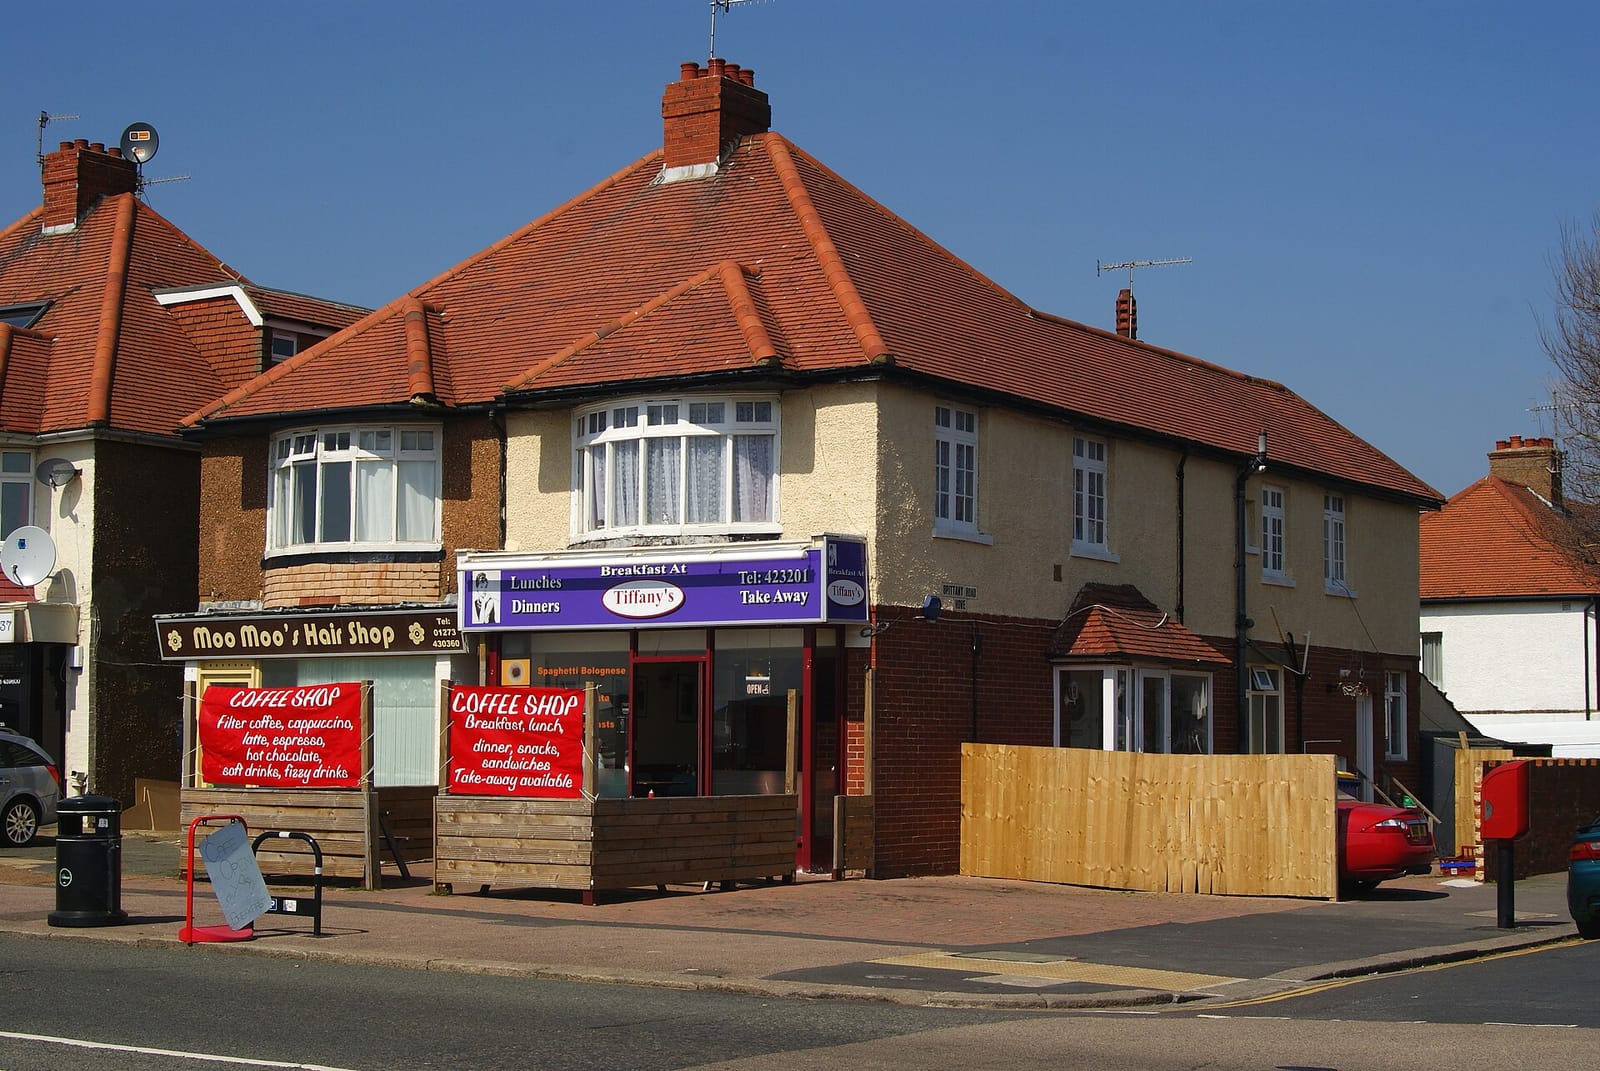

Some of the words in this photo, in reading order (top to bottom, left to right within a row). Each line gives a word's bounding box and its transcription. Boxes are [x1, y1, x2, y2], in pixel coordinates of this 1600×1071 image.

[600, 564, 667, 577] Breakfast
[669, 563, 688, 575] At
[738, 570, 762, 585] Tel:
[764, 568, 809, 584] 423201
[828, 567, 856, 576] Breakfast
[510, 575, 562, 590] Lunches
[613, 588, 675, 607] Tiffany's
[740, 589, 771, 604] Take
[773, 588, 809, 606] Away
[832, 585, 861, 600] Tiffany's
[511, 599, 561, 614] Dinners
[436, 617, 450, 625] Tel:
[193, 626, 236, 649] Moo
[240, 623, 299, 647] Moo's
[303, 622, 342, 646] Hair
[348, 621, 395, 649] Shop
[433, 629, 456, 637] 01273
[537, 667, 578, 676] Spaghetti
[581, 666, 626, 677] Bolognese
[229, 690, 294, 708] COFFEE
[290, 687, 341, 707] SHOP
[746, 683, 762, 695] OPEN
[452, 692, 522, 714] COFFEE
[523, 694, 578, 716] SHOP
[216, 714, 247, 729] Filter
[249, 714, 285, 731] coffee,
[287, 715, 354, 734] cappuccino,
[465, 714, 525, 733] Breakfast,
[528, 717, 564, 734] lunch,
[242, 731, 270, 747] latte,
[272, 735, 326, 751] espresso,
[473, 738, 514, 755] dinner,
[517, 740, 560, 757] snacks,
[246, 747, 264, 762] hot
[265, 748, 322, 764] chocolate,
[481, 756, 551, 771] sandwiches
[222, 762, 243, 777] soft
[244, 762, 282, 779] drinks,
[284, 764, 311, 784] fizzy
[313, 764, 349, 779] drinks
[454, 768, 518, 791] Take-away
[519, 772, 573, 788] available
